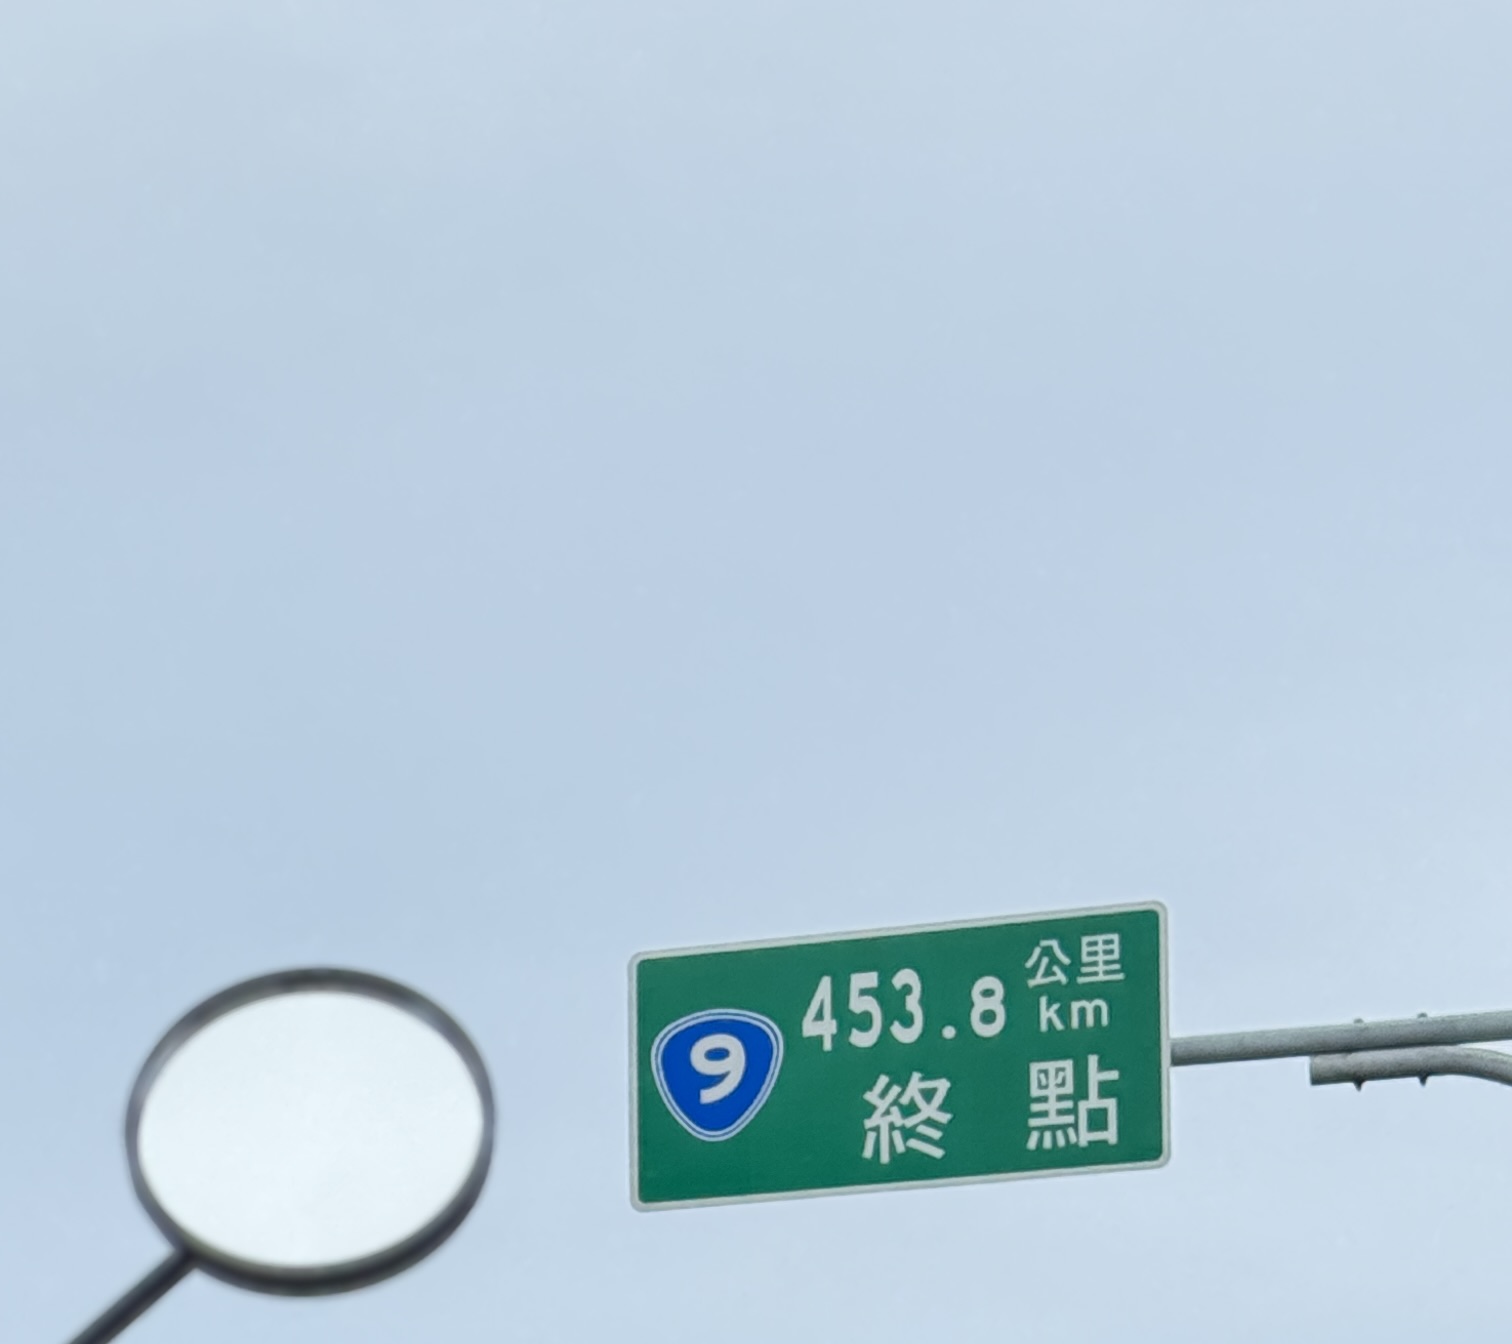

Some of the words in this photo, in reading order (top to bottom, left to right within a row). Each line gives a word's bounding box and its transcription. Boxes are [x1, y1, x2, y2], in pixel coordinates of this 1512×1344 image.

[1025, 933, 1125, 988] 公里
[802, 968, 1006, 1052] 453.8
[1039, 996, 1109, 1032] km
[690, 1033, 746, 1104] 9
[863, 1054, 1119, 1164] 終點
